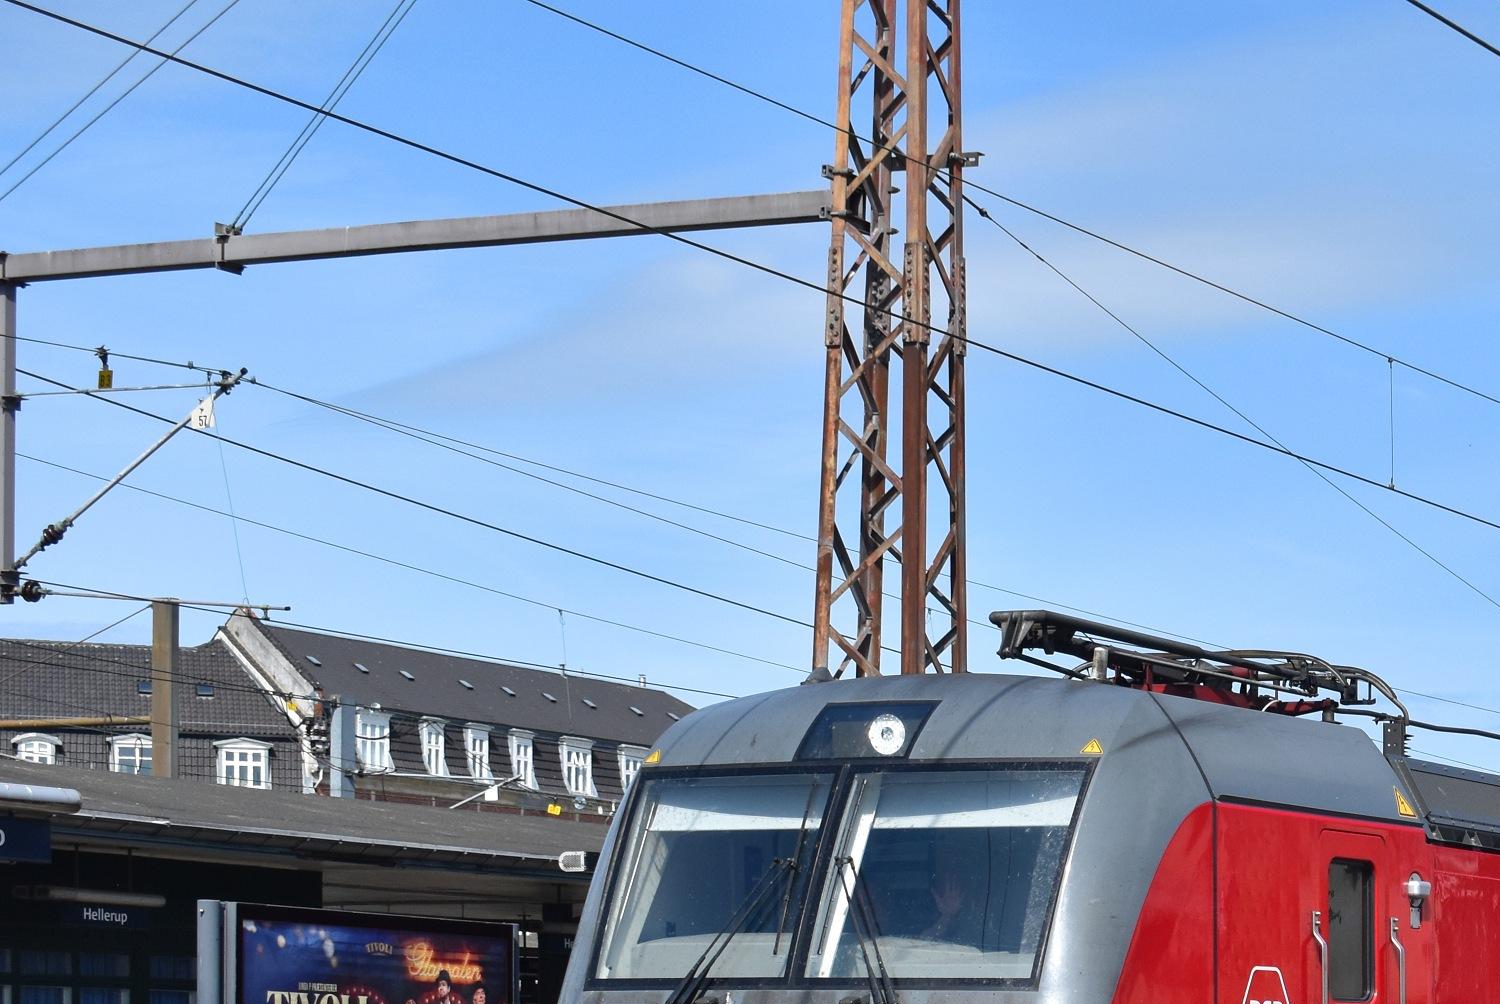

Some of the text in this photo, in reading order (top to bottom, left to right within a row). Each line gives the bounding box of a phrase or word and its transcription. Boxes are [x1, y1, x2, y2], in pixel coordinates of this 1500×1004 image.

[198, 415, 208, 427] 57
[83, 907, 128, 925] Hellerup
[365, 942, 393, 955] TIVOLI
